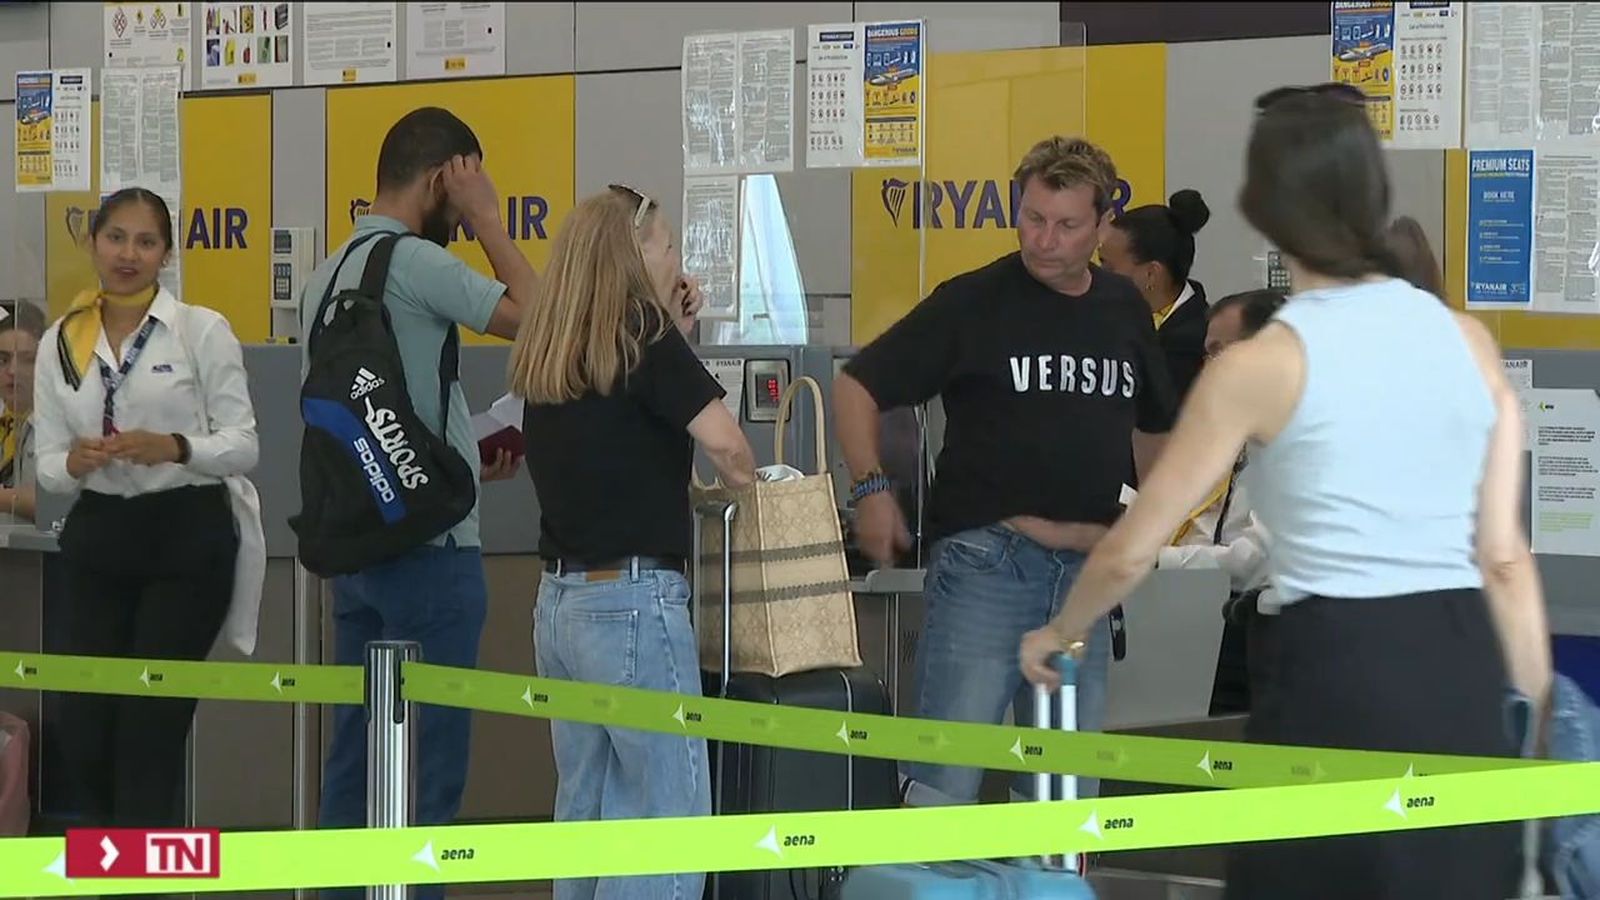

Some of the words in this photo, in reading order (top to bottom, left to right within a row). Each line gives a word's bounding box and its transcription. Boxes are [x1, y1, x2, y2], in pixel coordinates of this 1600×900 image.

[1472, 158, 1506, 172] PREMIUM
[1508, 158, 1530, 171] SEATS
[1009, 354, 1136, 399] VERSUS
[350, 377, 385, 400] adidas
[364, 396, 429, 490] SPORTS
[353, 437, 396, 503] adidas
[533, 692, 549, 703] aena
[686, 711, 702, 722] aena
[850, 729, 868, 741] aena
[1024, 745, 1043, 757] aena
[1213, 760, 1233, 771] aena
[1407, 796, 1435, 808] aena
[1104, 817, 1134, 830] aena
[783, 833, 815, 847] aena
[441, 848, 475, 861] aena
